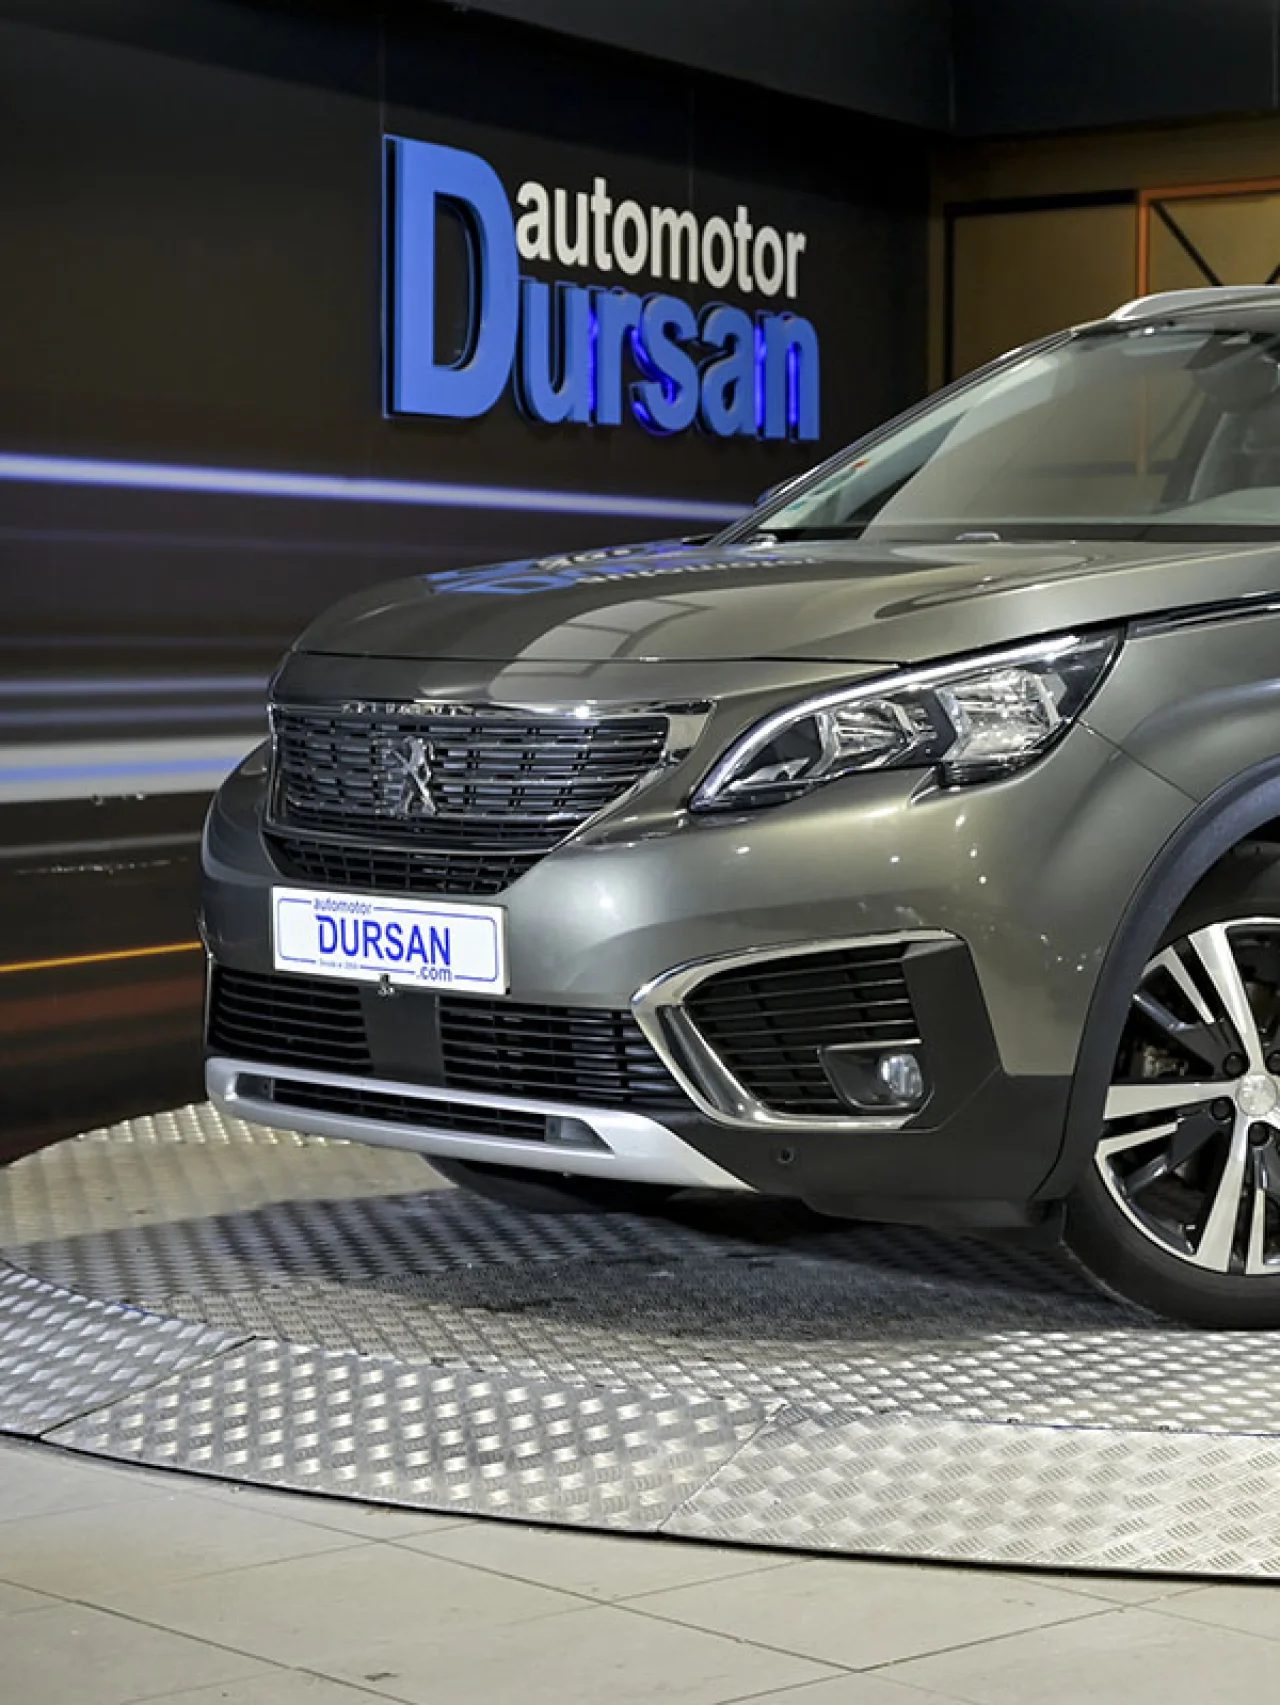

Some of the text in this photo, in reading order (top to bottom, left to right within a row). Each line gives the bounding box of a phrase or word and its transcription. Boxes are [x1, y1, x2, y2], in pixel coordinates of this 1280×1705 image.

[516, 177, 806, 299] automotor
[382, 133, 820, 443] Dursan
[313, 898, 371, 915] automotor
[315, 914, 451, 966] DURSAN
[417, 966, 453, 983] .com
